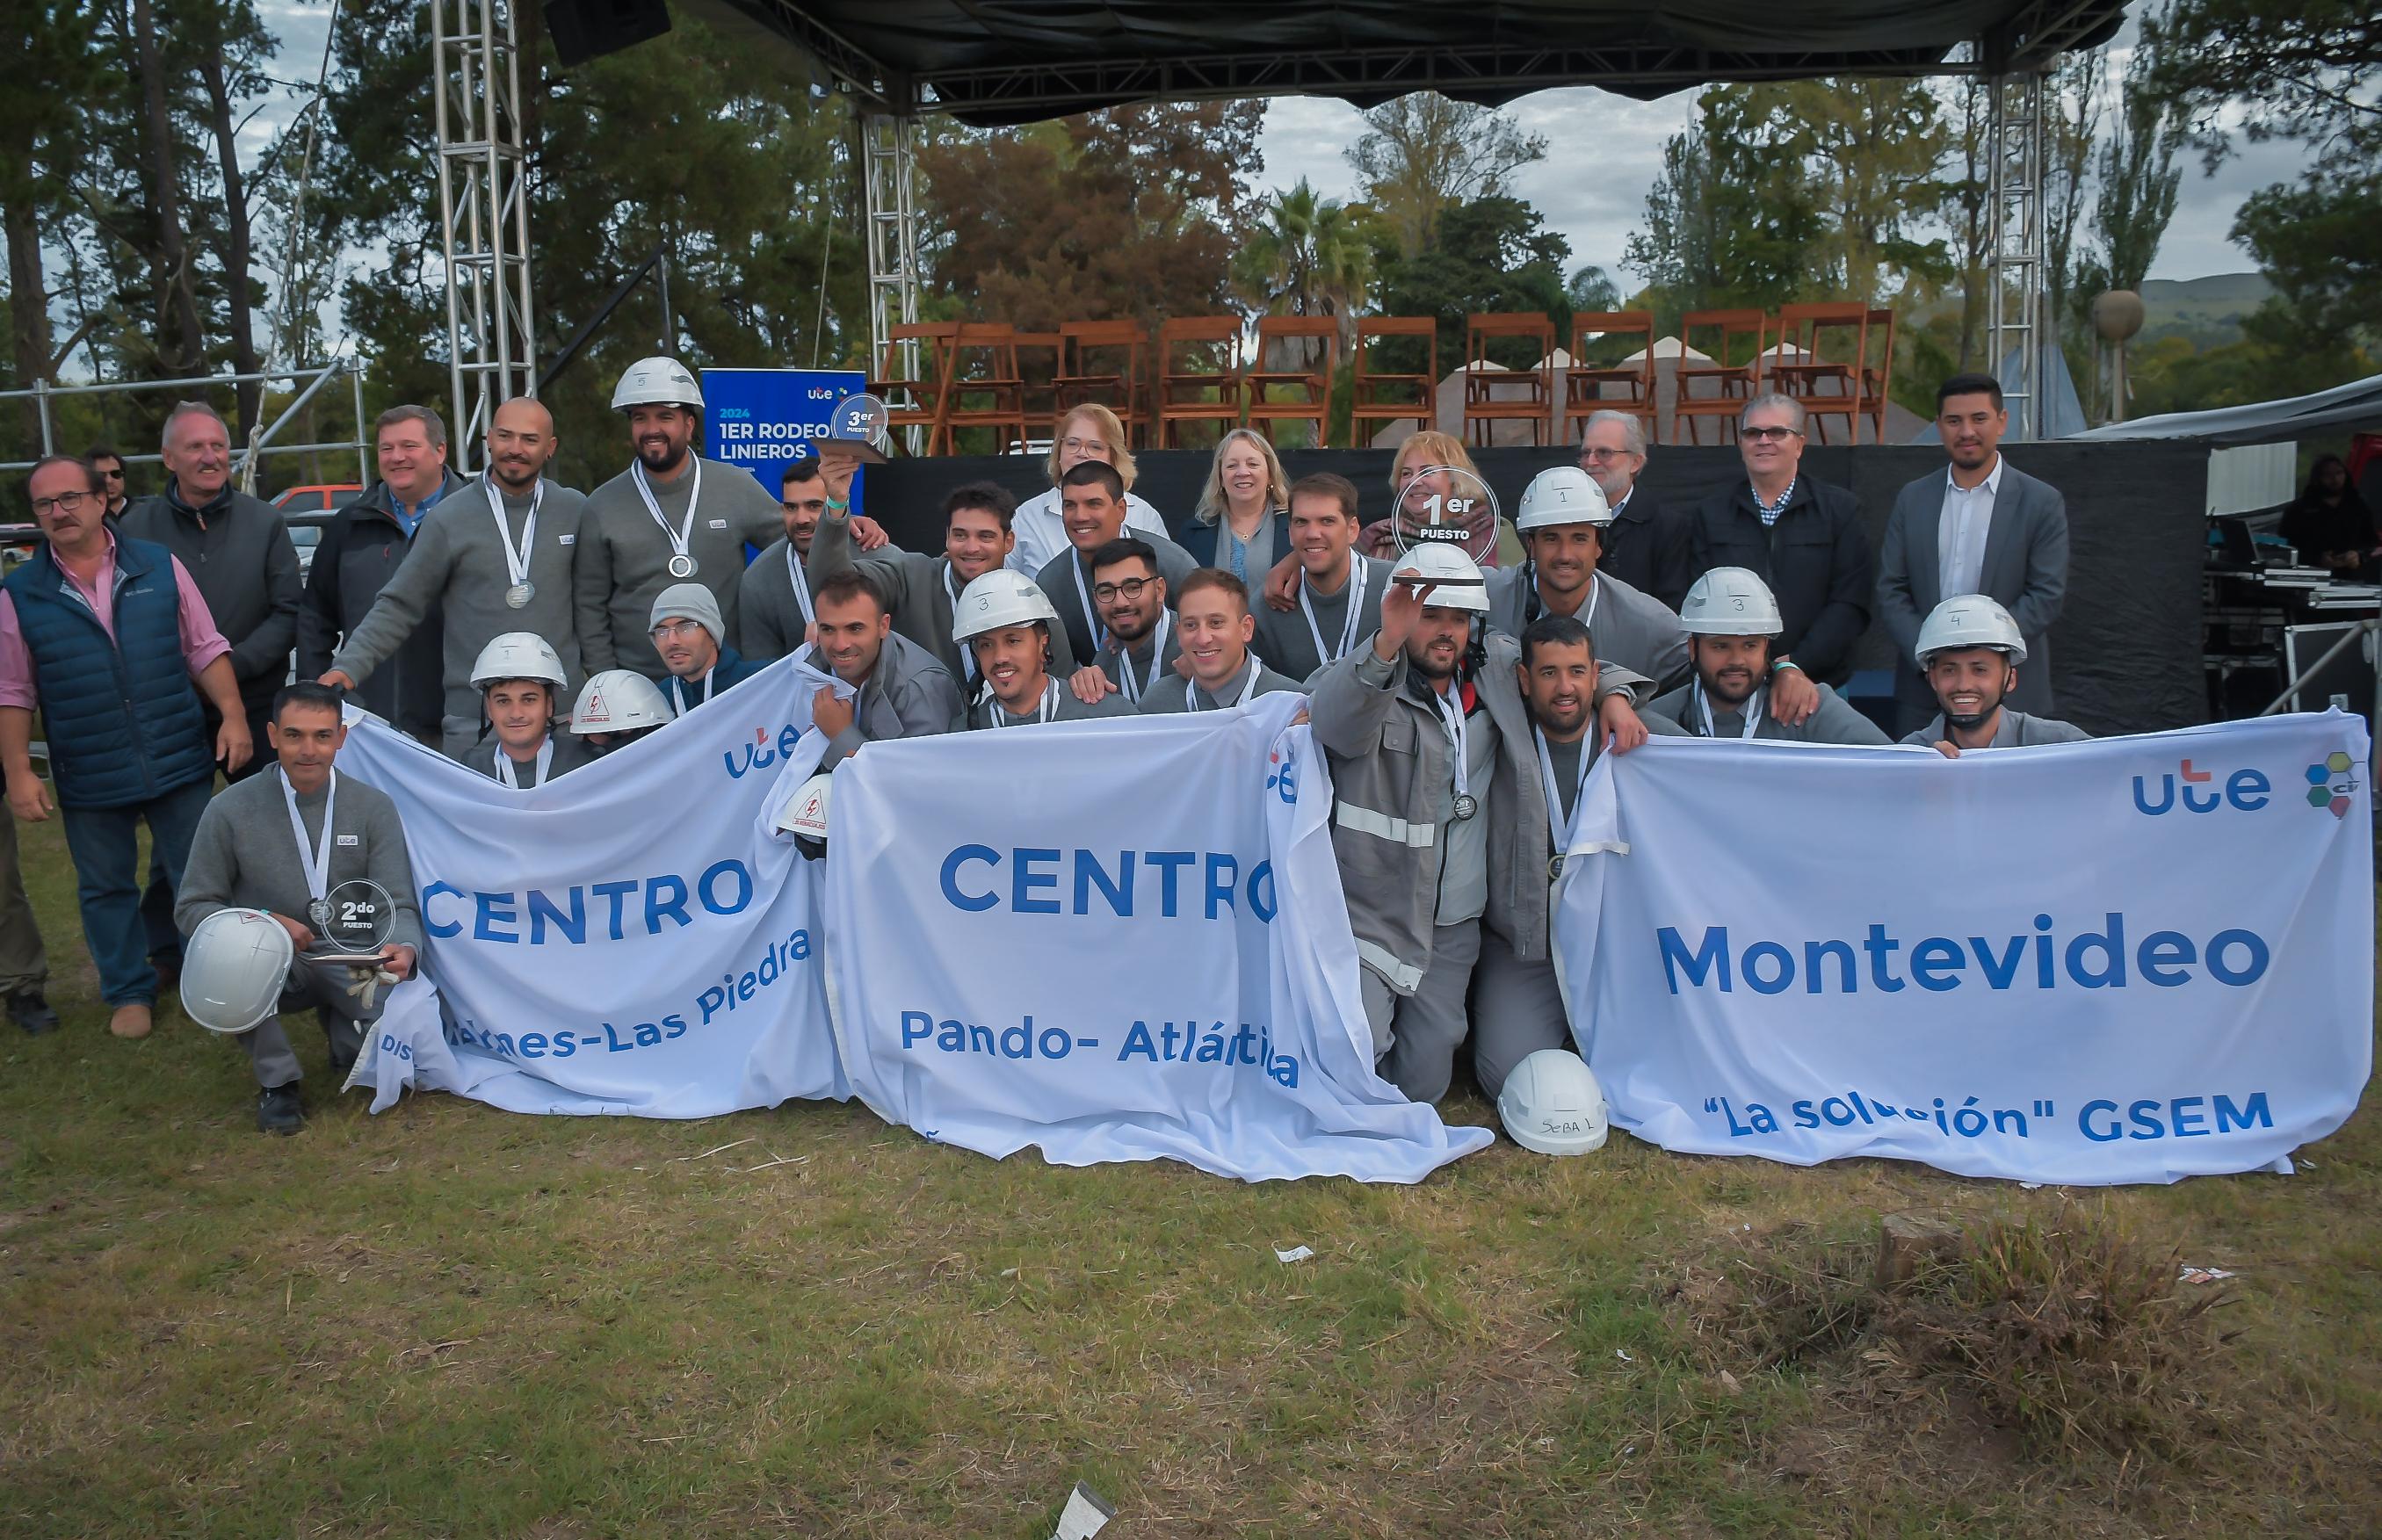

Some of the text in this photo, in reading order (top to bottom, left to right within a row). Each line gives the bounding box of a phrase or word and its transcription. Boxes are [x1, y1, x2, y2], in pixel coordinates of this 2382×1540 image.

[808, 387, 833, 400] ute
[719, 408, 750, 419] 2024
[719, 423, 830, 439] 1ER RODEO
[720, 444, 807, 459] LINIEROS
[1420, 528, 1470, 540] PUESTO
[979, 597, 989, 611] 3
[1732, 598, 1744, 611] 3
[723, 724, 801, 779] ute
[2132, 758, 2271, 816] ute
[340, 901, 376, 921] 2do
[422, 858, 754, 945] CENTRO
[1655, 911, 2270, 995] Montevideo
[696, 929, 812, 1026] Piedra
[901, 1010, 1099, 1059] Pando-
[2078, 1092, 2275, 1142] GSEM
